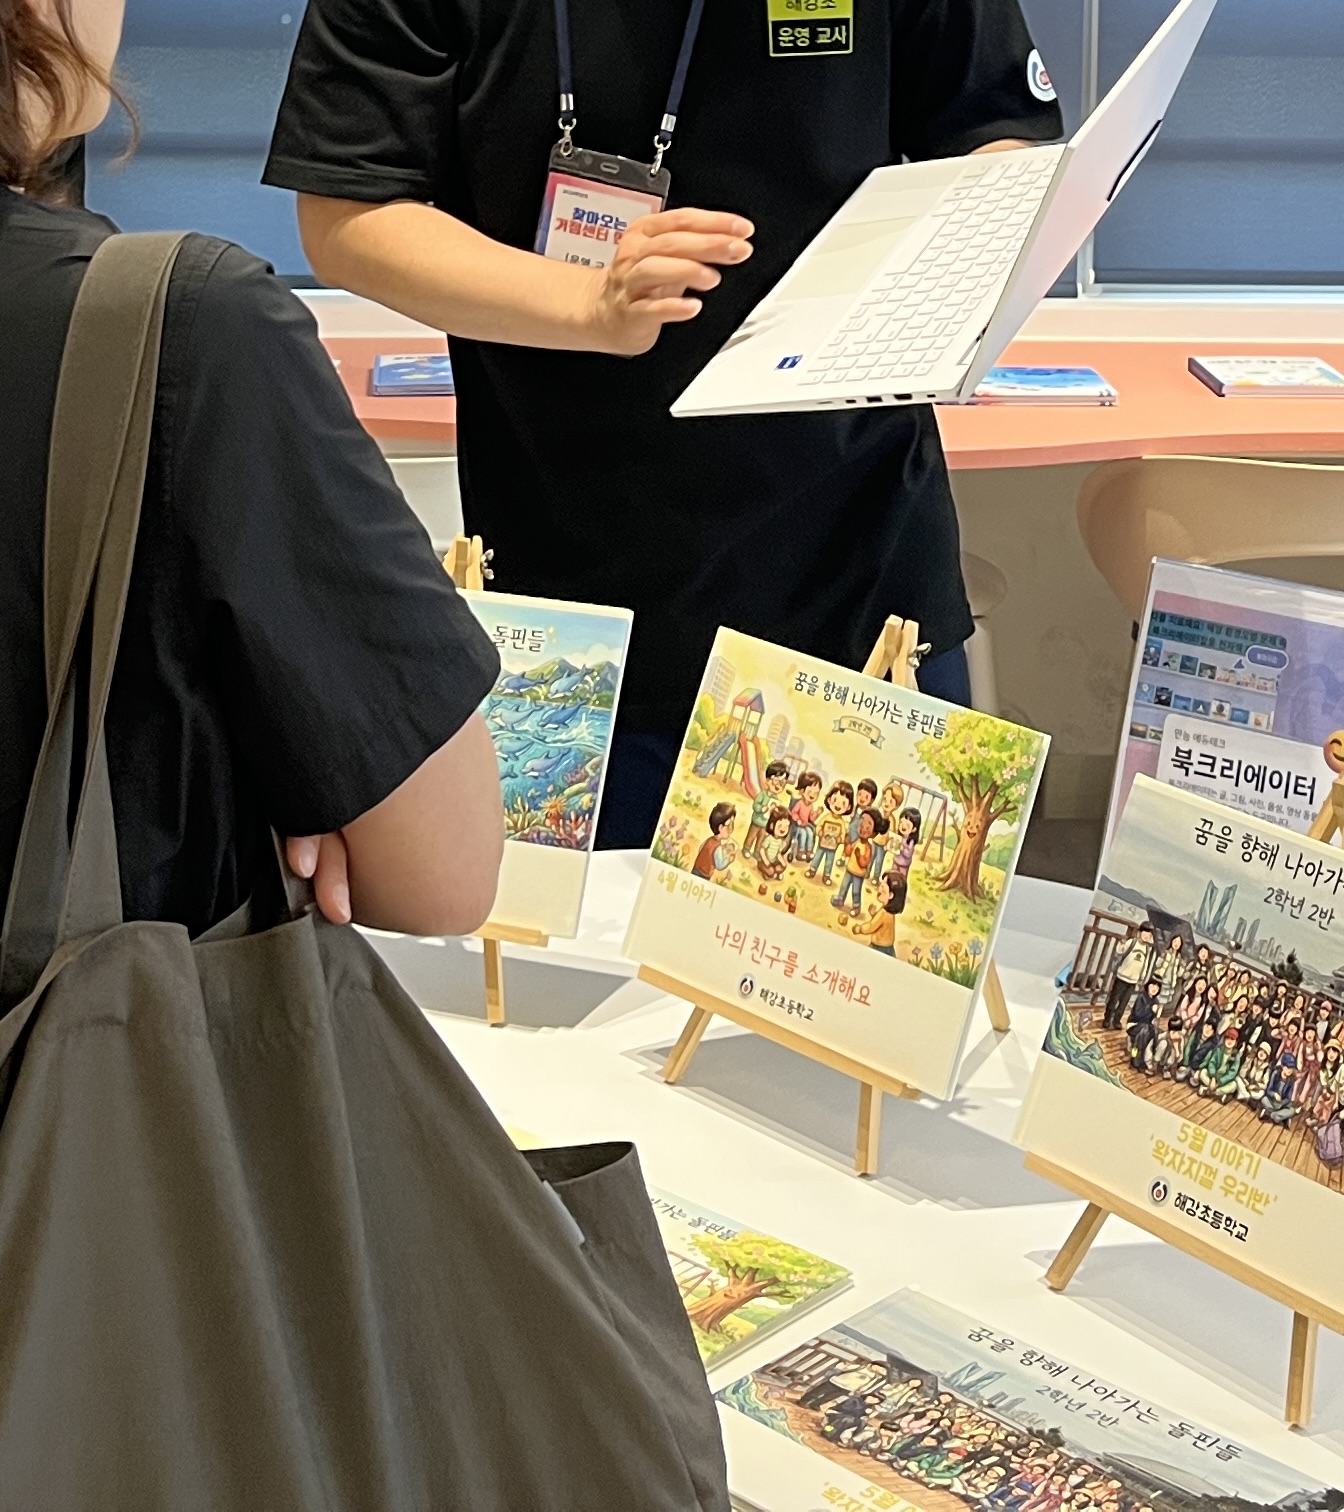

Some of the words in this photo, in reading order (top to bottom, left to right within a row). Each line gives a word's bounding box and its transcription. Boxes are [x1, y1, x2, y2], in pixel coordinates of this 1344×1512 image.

[778, 27, 810, 47] 운영
[815, 25, 847, 44] 교사
[555, 217, 610, 242] 거점센터
[572, 207, 627, 231] 찾아오는
[492, 625, 545, 653] 돌핀들
[794, 671, 819, 696] 꿈을
[823, 680, 850, 707] 향해
[851, 691, 903, 725] 나아가는
[906, 708, 947, 740] 돌핀들
[1170, 745, 1317, 805] 북크리에이터
[1194, 817, 1234, 854] 꿈을
[1241, 833, 1280, 871] 향해
[656, 869, 679, 894] 4월
[680, 879, 718, 910] 이야기
[1263, 886, 1306, 920] 2학년
[1307, 904, 1336, 931] 2반
[714, 923, 748, 956] 나의
[750, 935, 800, 979] 친구를
[801, 962, 872, 1007] 소개해요
[759, 987, 815, 1022] 해강초등학교
[1176, 1122, 1208, 1154] 5월
[1210, 1137, 1262, 1180] 이야기
[1174, 1192, 1249, 1242] 해강초등학교
[967, 1326, 1015, 1354] 꿈을
[1019, 1350, 1070, 1378] 향해
[1070, 1374, 1160, 1424] 나아가는
[1167, 1421, 1244, 1462] 돌핀들
[1035, 1384, 1088, 1412] 2학년
[1085, 1408, 1119, 1429] 2반
